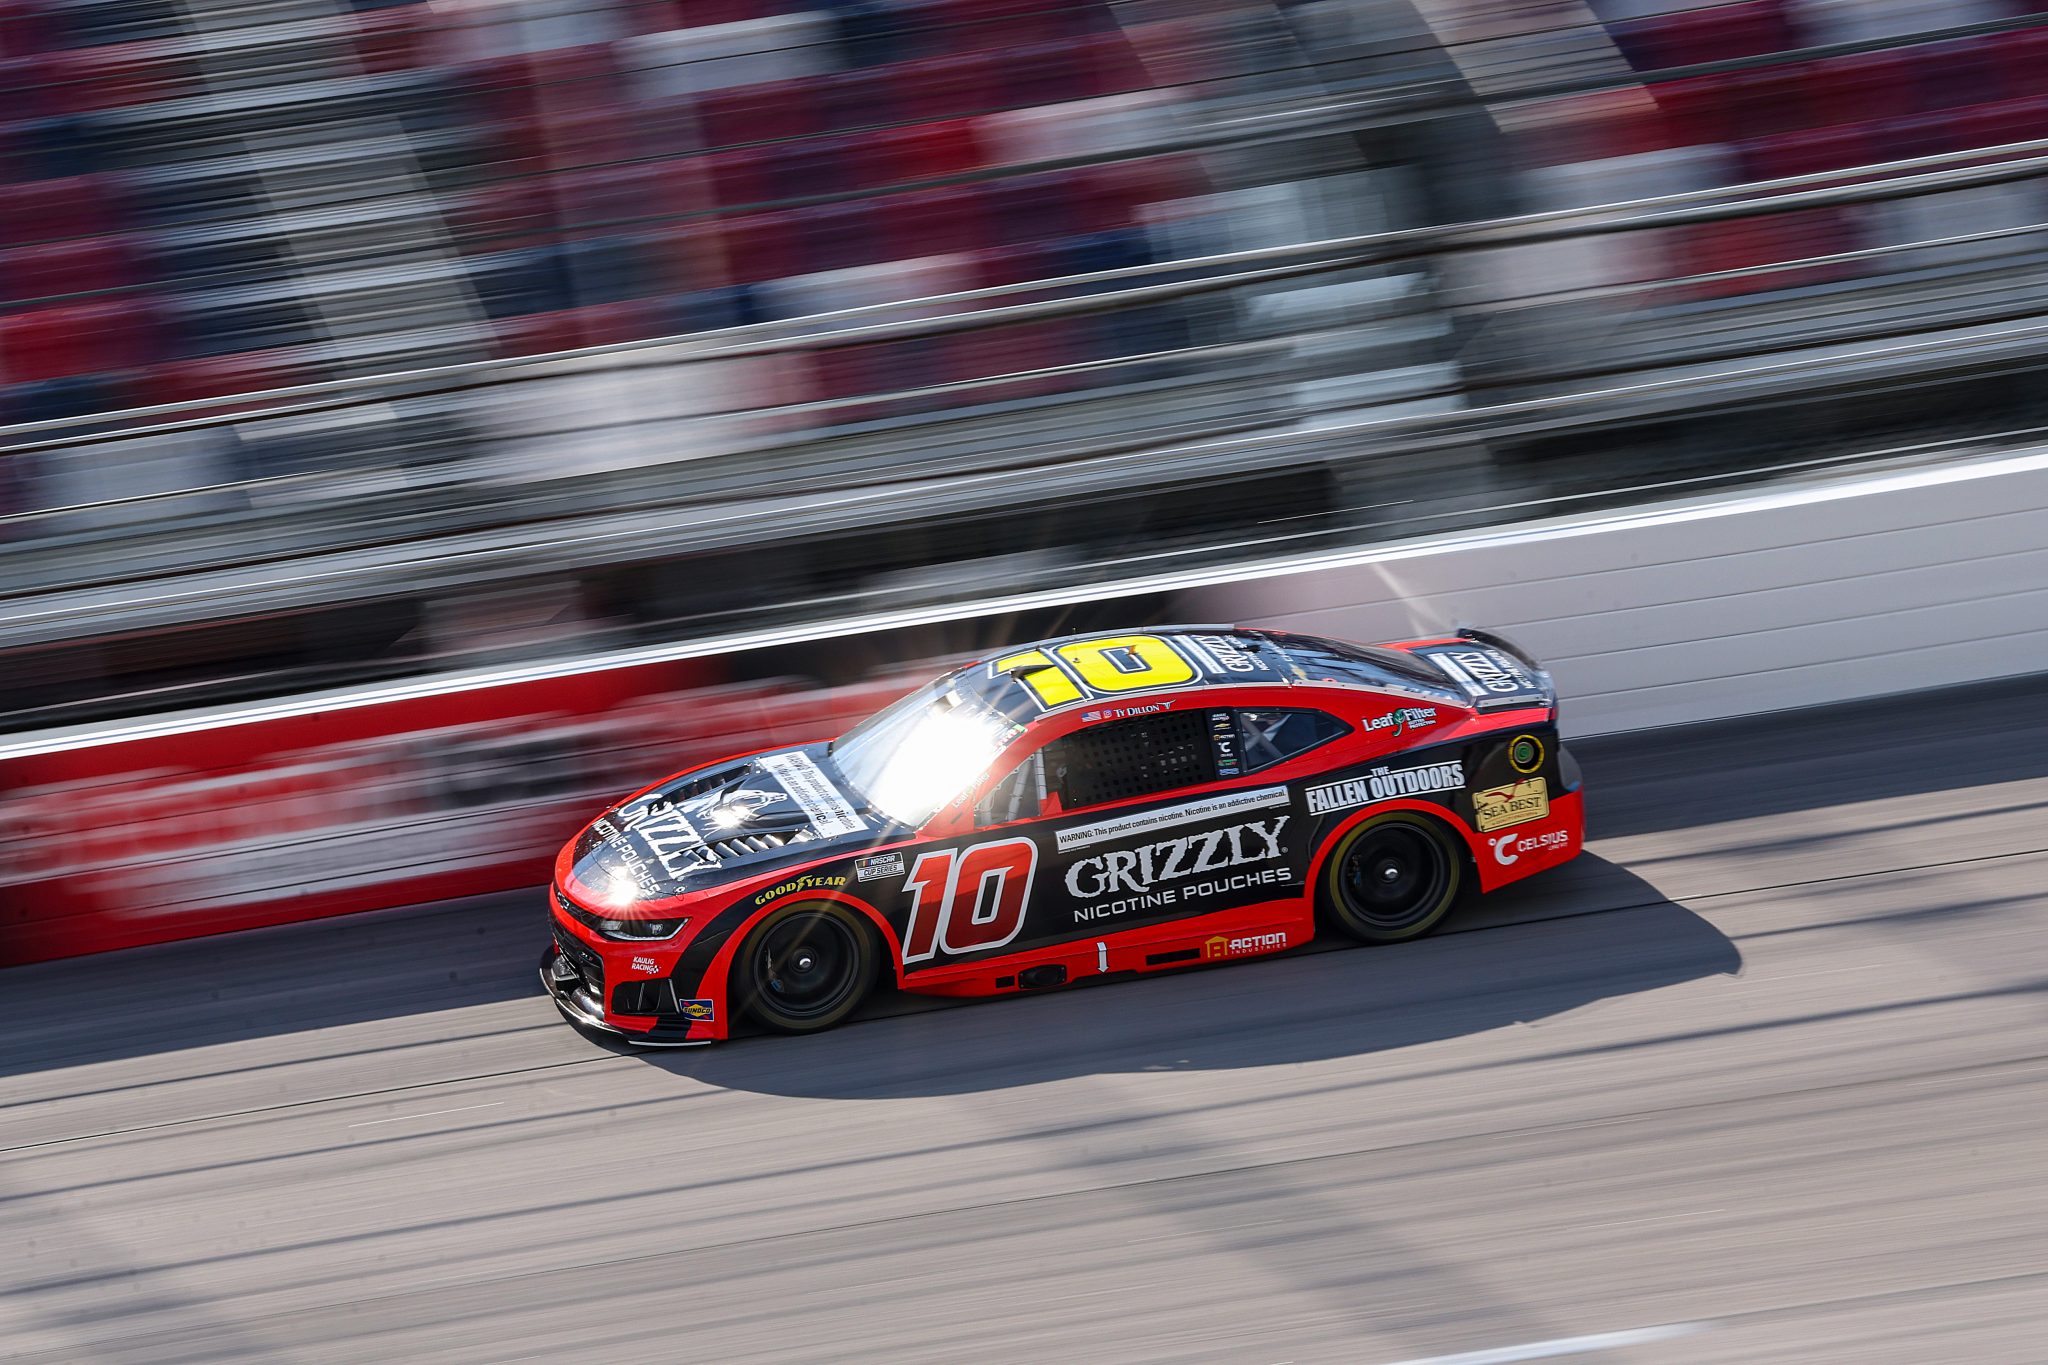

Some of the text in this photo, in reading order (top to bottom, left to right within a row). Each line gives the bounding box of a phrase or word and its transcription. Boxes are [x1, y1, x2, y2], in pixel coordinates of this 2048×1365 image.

[988, 634, 1203, 712] 10
[1448, 652, 1519, 692] GRIZZLY
[1362, 707, 1437, 732] Leaf Filter
[1370, 766, 1390, 777] THE
[1305, 763, 1466, 813] FALLEN OUTDOORS
[1059, 789, 1286, 843] WARNING: This product contains nicotine. Nicotine is an addictive chemical.
[1483, 804, 1508, 820] SEA
[1509, 796, 1541, 811] BEST
[1517, 830, 1568, 852] CELSIUS
[619, 841, 661, 897] POUCHES
[870, 855, 896, 866] NASCAR
[1065, 815, 1291, 898] GRIZZLY
[864, 864, 898, 876] CUP SERIES
[755, 875, 846, 905] GOODYEAR
[901, 836, 1039, 965] 10
[1074, 867, 1292, 923] NICOTINE POUCHES
[1229, 931, 1287, 950] ACTION
[631, 963, 653, 972] RACING
[633, 956, 654, 965] KAULIG
[682, 1006, 712, 1015] SUNOCO
